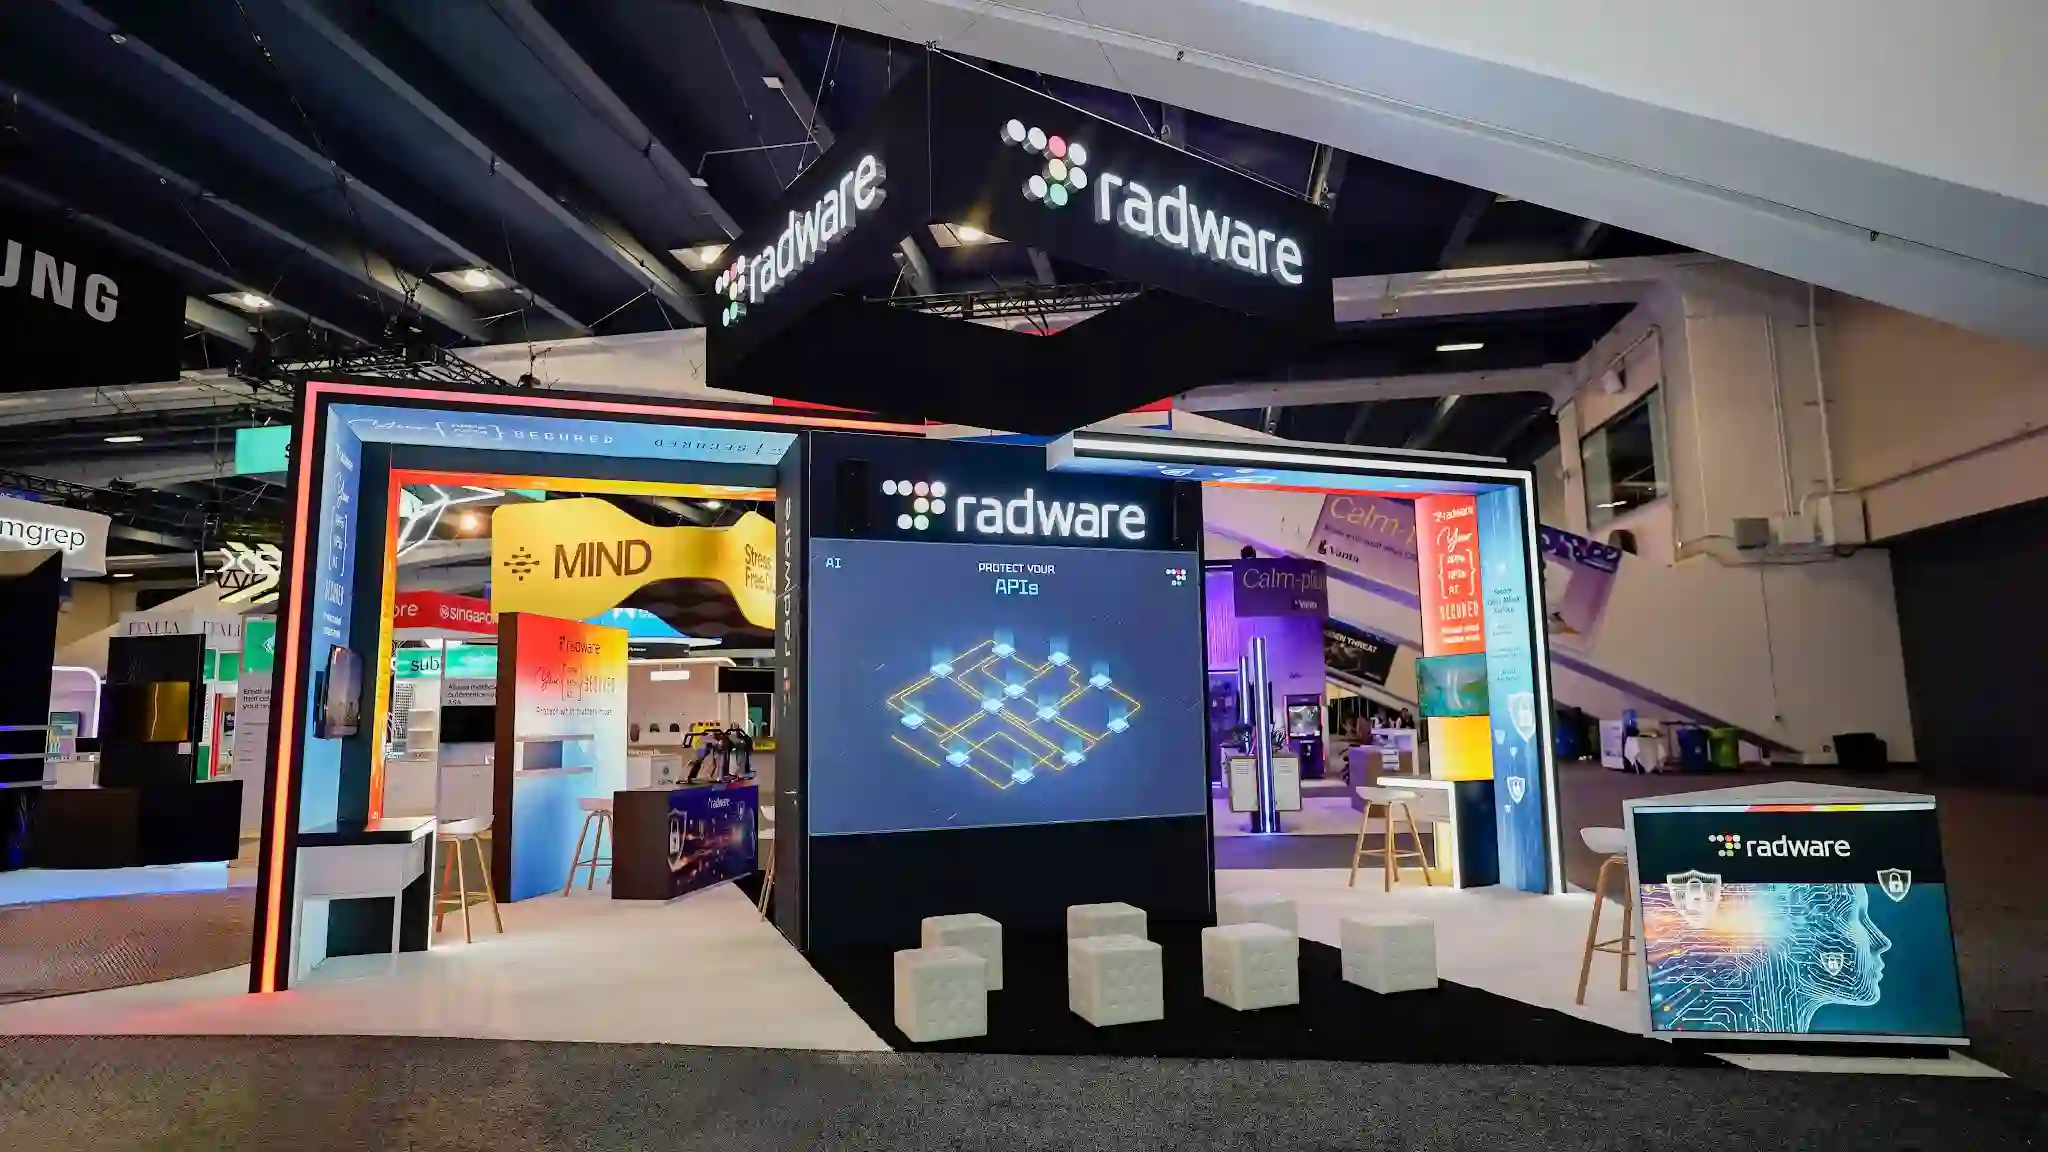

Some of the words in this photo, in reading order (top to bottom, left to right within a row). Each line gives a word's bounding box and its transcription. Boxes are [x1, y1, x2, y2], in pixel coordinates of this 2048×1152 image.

[750, 155, 886, 303] radware
[1097, 172, 1304, 285] radware
[514, 431, 614, 444] SECURED
[956, 488, 1146, 540] radware
[0, 520, 85, 551] mgrep
[554, 539, 652, 580] MIND
[745, 543, 772, 571] Stress
[825, 557, 841, 568] AI
[978, 563, 1025, 573] PROTECT
[1027, 564, 1056, 574] YOUR
[995, 579, 1039, 596] APIs
[1347, 637, 1378, 653] THREAT
[411, 656, 440, 672] sub
[1746, 834, 1851, 858] radware
